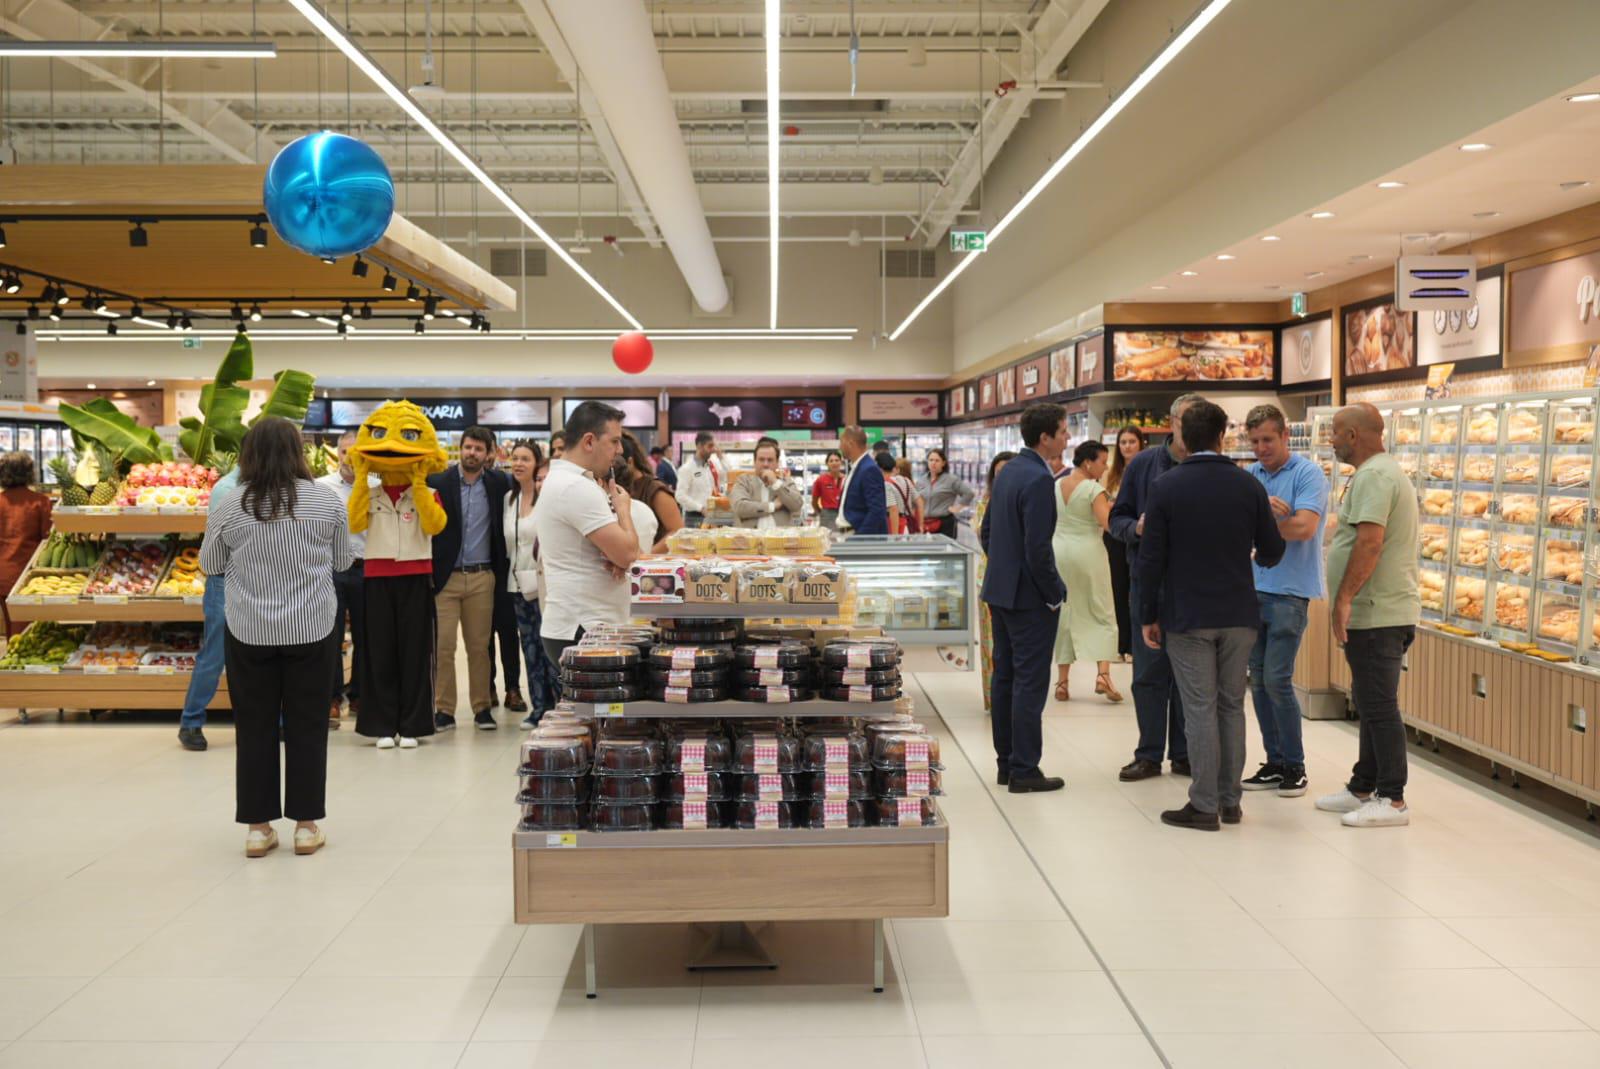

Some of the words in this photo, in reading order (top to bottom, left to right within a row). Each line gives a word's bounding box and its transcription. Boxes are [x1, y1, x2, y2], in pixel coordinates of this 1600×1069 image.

[696, 583, 722, 598] DOTS
[750, 584, 777, 598] DOTS
[804, 583, 831, 597] DOTS
